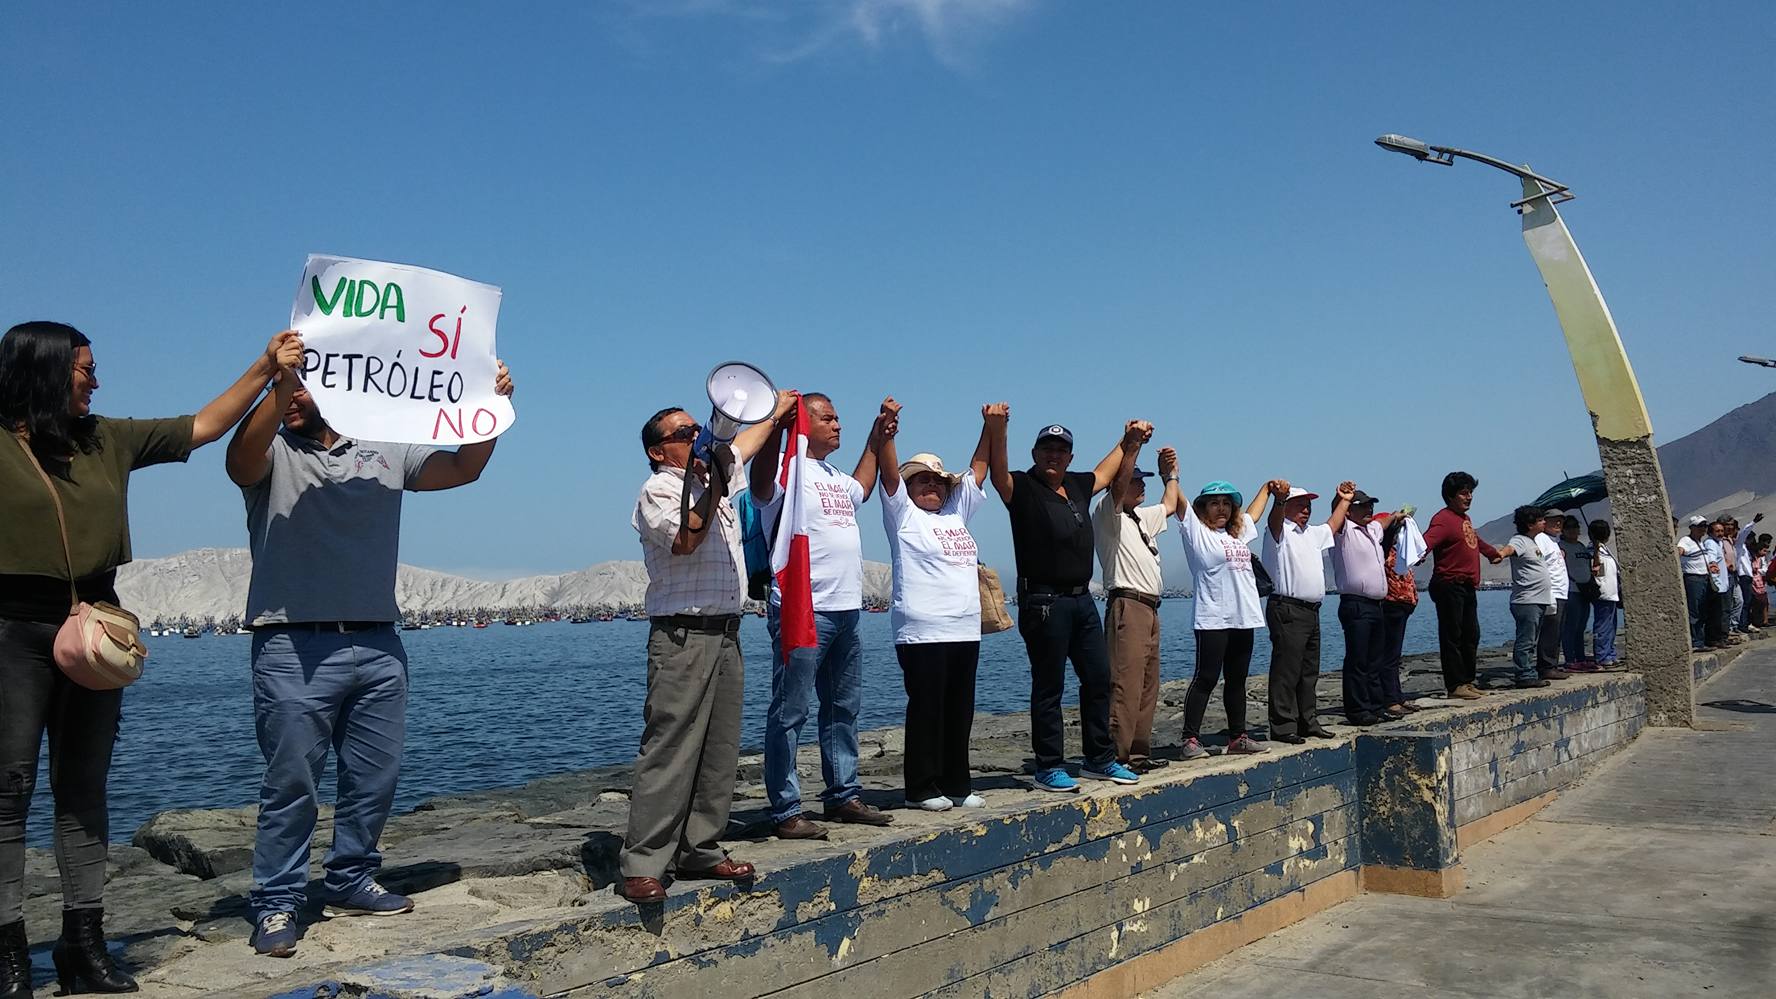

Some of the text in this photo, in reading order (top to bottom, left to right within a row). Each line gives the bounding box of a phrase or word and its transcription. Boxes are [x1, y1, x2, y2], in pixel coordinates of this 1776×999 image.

[311, 274, 405, 323] VIDA
[418, 305, 467, 360] SÍ
[301, 349, 464, 404] PETRÓLEO
[432, 408, 497, 440] NO
[814, 482, 827, 490] EL
[821, 498, 852, 510] EL MAR
[933, 528, 968, 537] EL MAR
[940, 541, 976, 550] EL MAR
